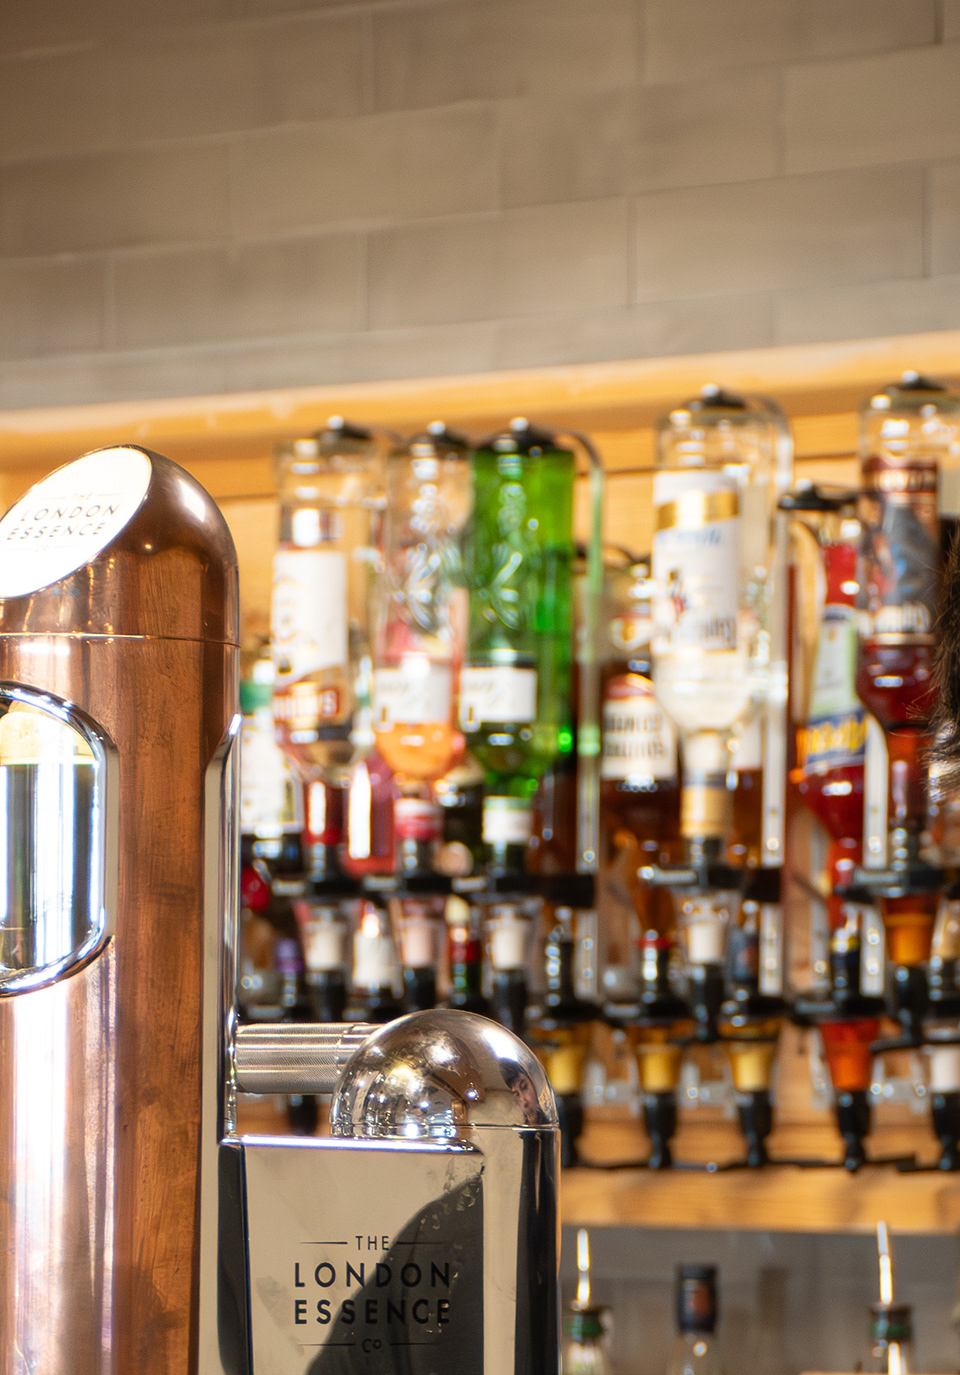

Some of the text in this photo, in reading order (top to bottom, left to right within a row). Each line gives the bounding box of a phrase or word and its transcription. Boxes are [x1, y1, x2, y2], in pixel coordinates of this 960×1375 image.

[20, 504, 120, 521] LONDON
[6, 522, 106, 541] ESSENCE
[355, 1235, 390, 1251] THE
[295, 1261, 450, 1288] LONDON
[295, 1299, 450, 1325] ESSENCE
